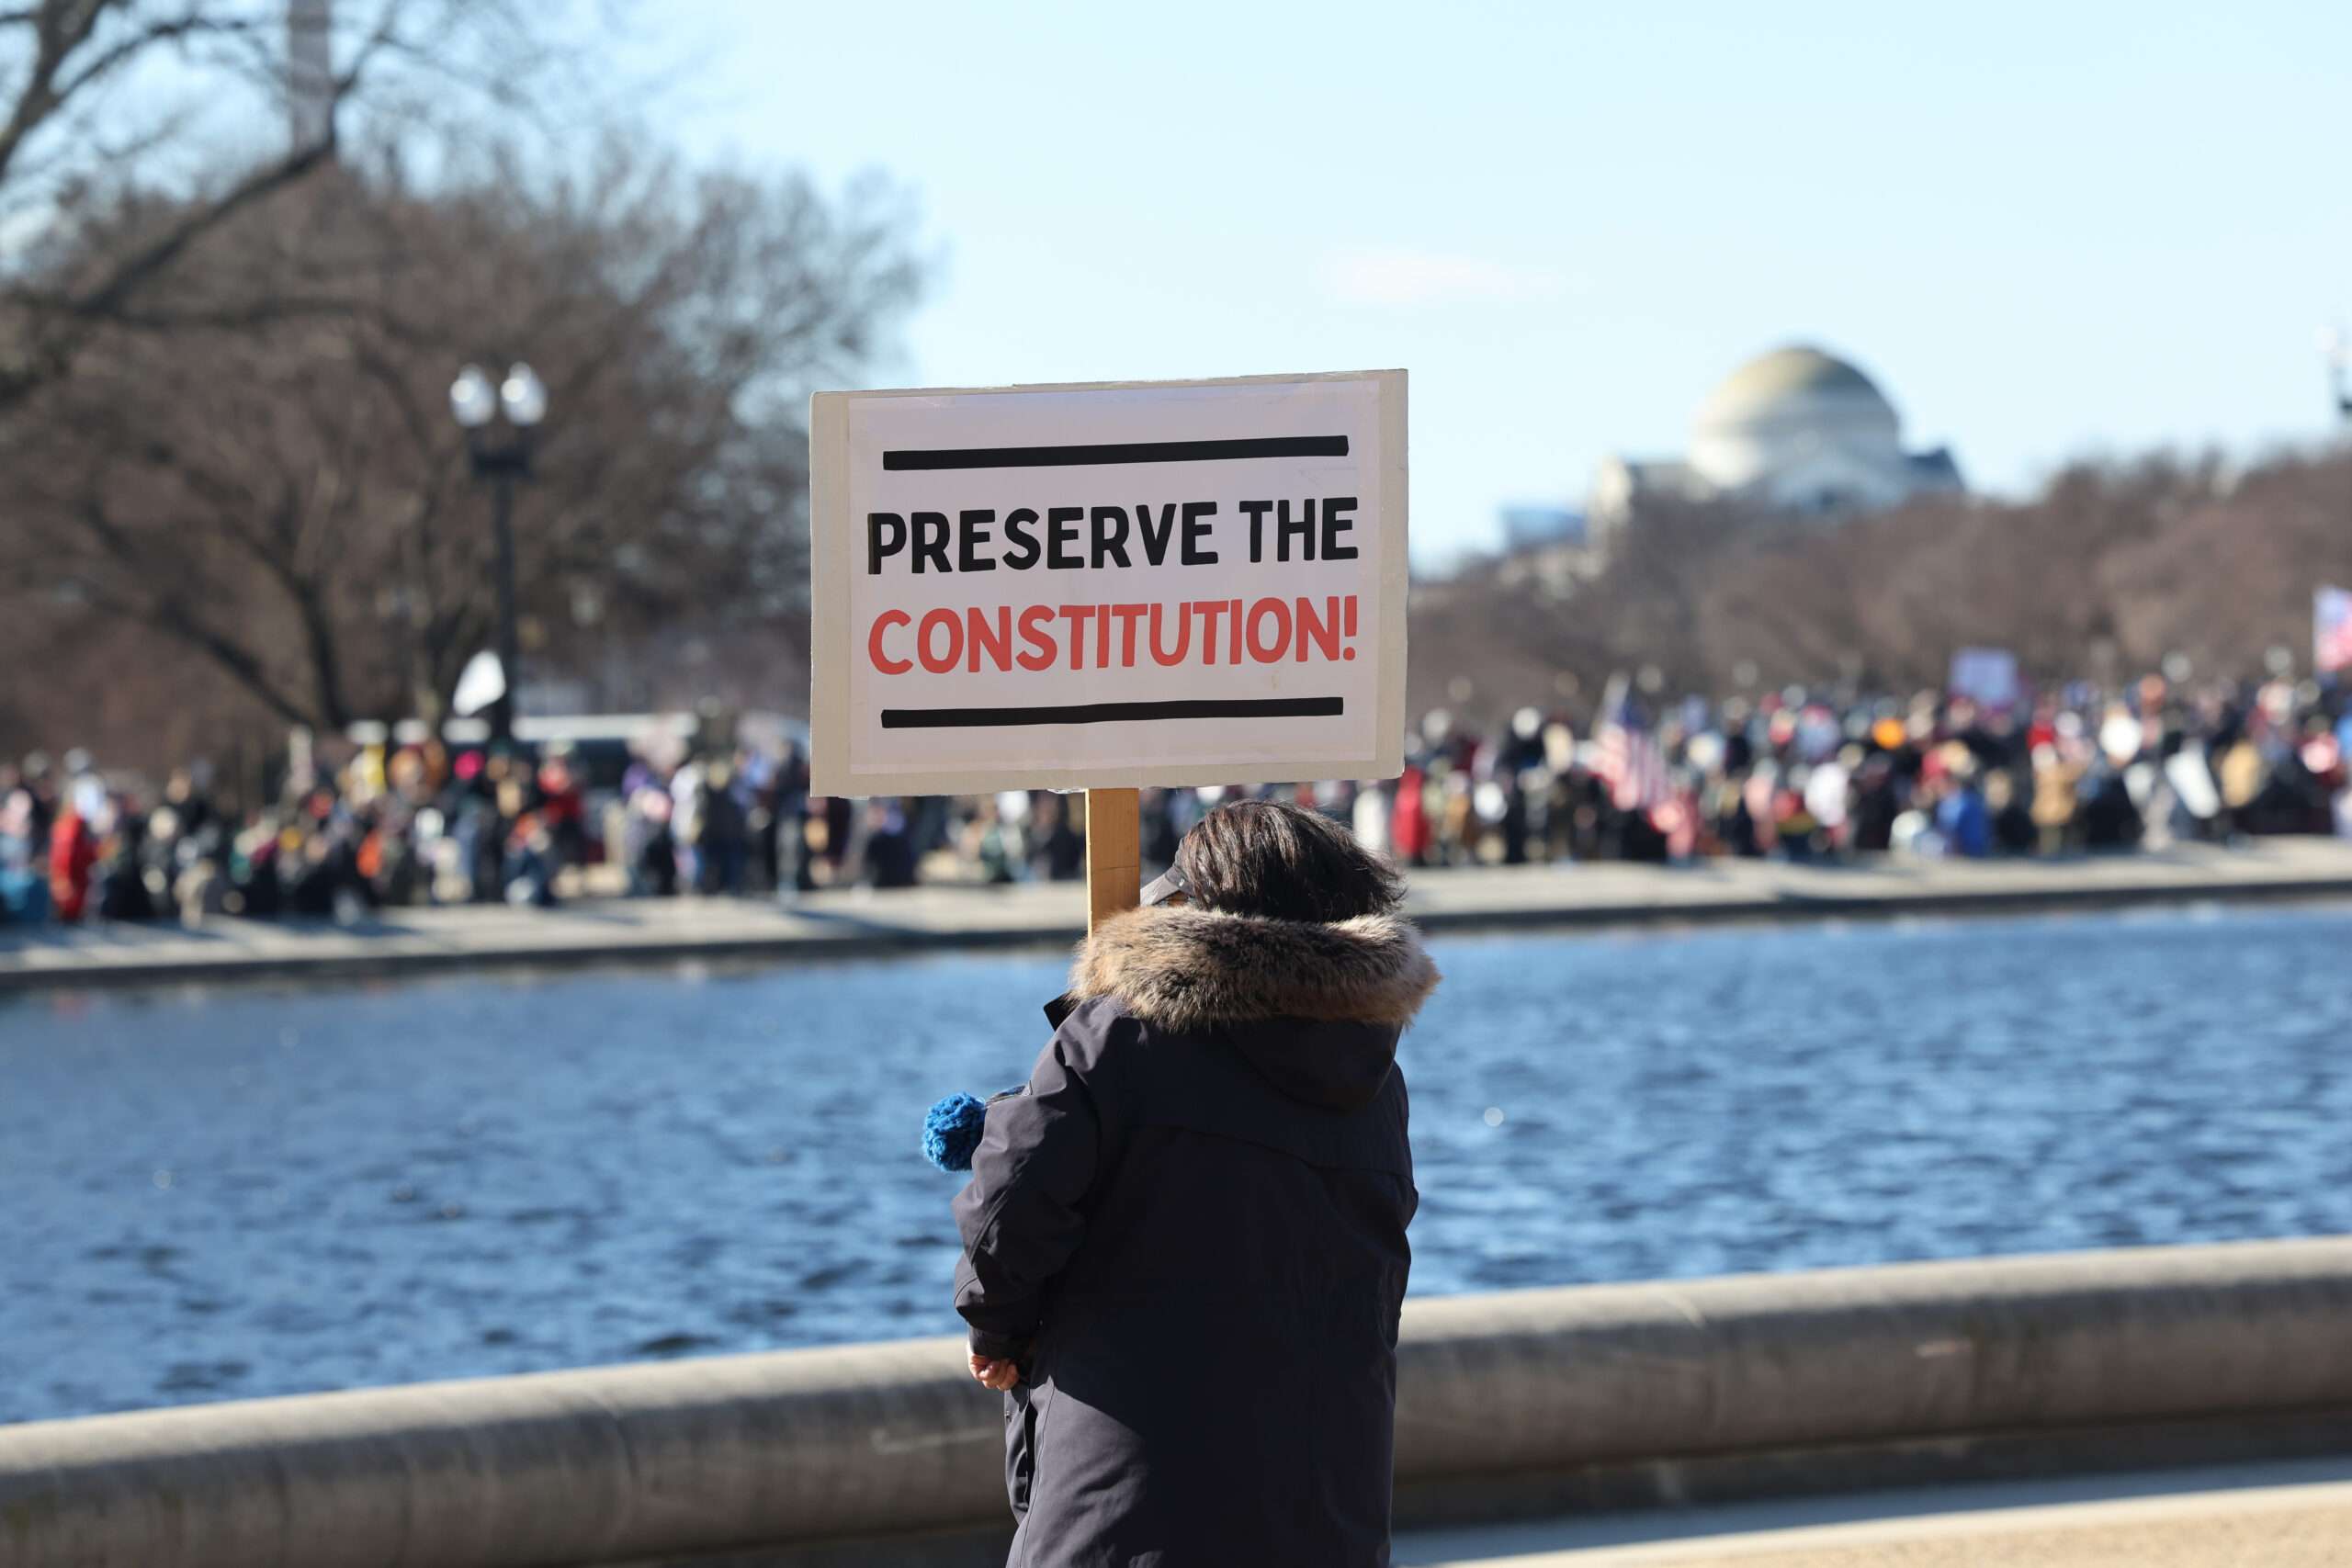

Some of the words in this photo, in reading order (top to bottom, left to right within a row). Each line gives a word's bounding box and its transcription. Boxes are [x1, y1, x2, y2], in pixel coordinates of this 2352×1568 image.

[867, 501, 1218, 574] PRESERVE
[1238, 497, 1358, 563] THE
[868, 595, 1358, 675] CONSTITUTION!
